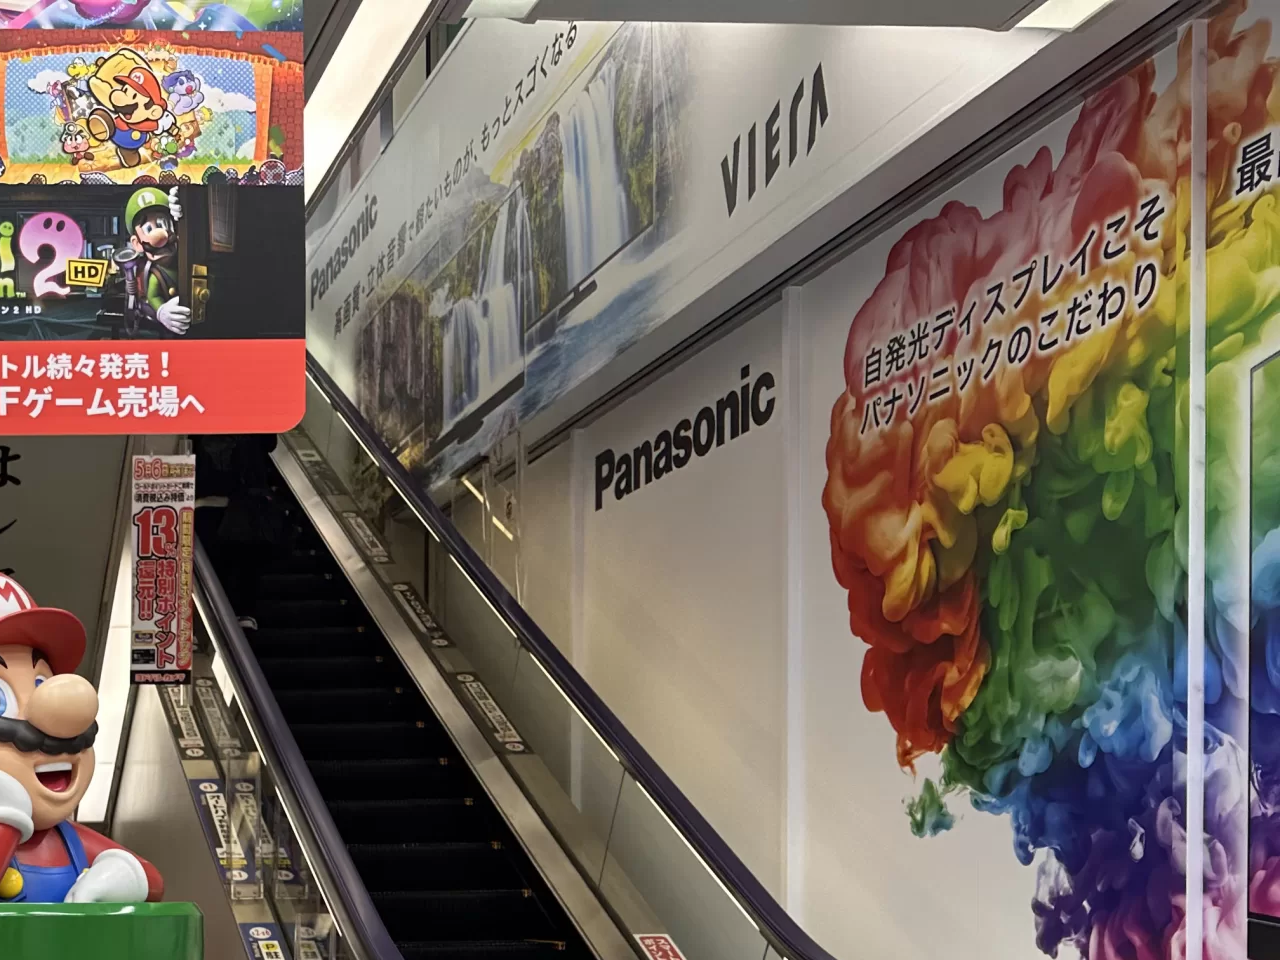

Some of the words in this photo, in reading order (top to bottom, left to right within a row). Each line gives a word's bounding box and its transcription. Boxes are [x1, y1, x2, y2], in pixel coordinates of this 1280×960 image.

[19, 211, 85, 298] 2
[74, 267, 100, 279] HD
[25, 305, 42, 315] HD
[308, 194, 378, 312] Panasonic
[863, 194, 1166, 389] 自発光ディスプレイこそ
[861, 263, 1158, 434] パナソニックのこだわり
[595, 364, 776, 512] Panasonic
